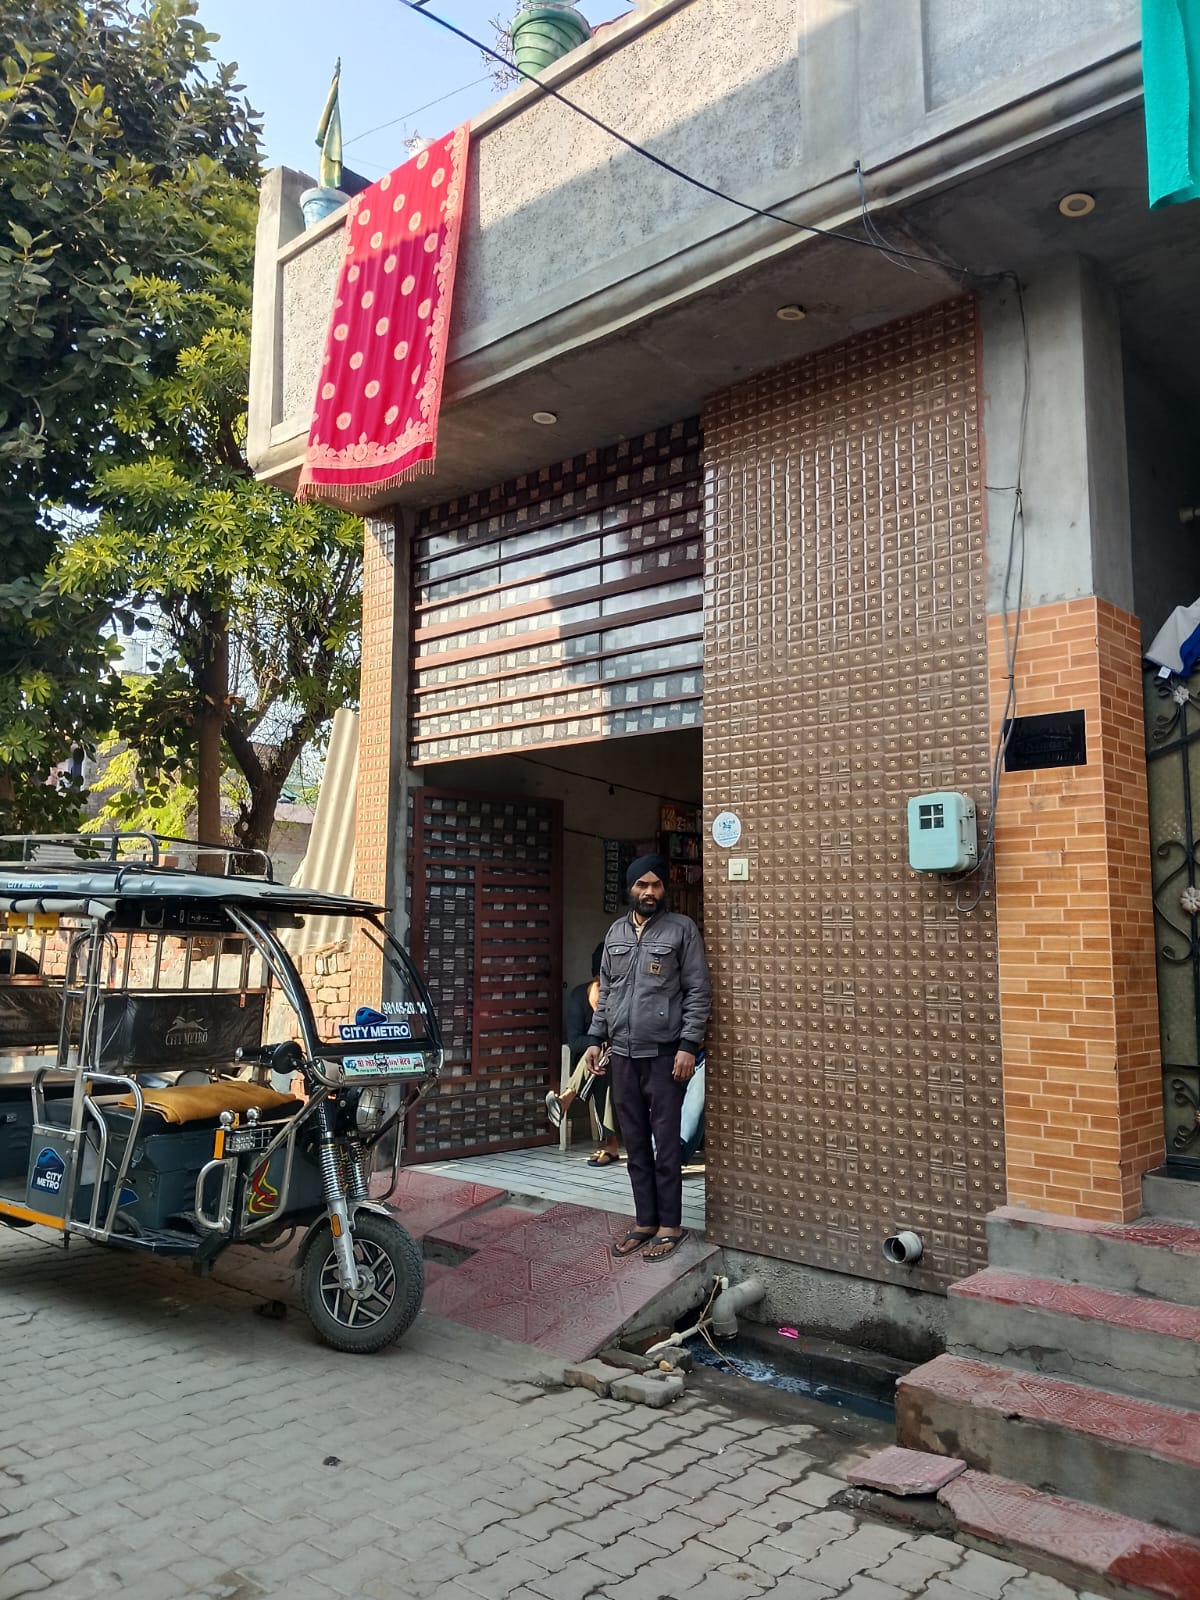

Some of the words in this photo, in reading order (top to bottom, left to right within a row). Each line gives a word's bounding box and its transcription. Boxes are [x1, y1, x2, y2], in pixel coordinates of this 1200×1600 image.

[342, 1026, 369, 1038] CITY
[371, 1025, 409, 1037] METRO
[37, 1176, 60, 1190] METRO
[46, 1171, 62, 1182] CITY
